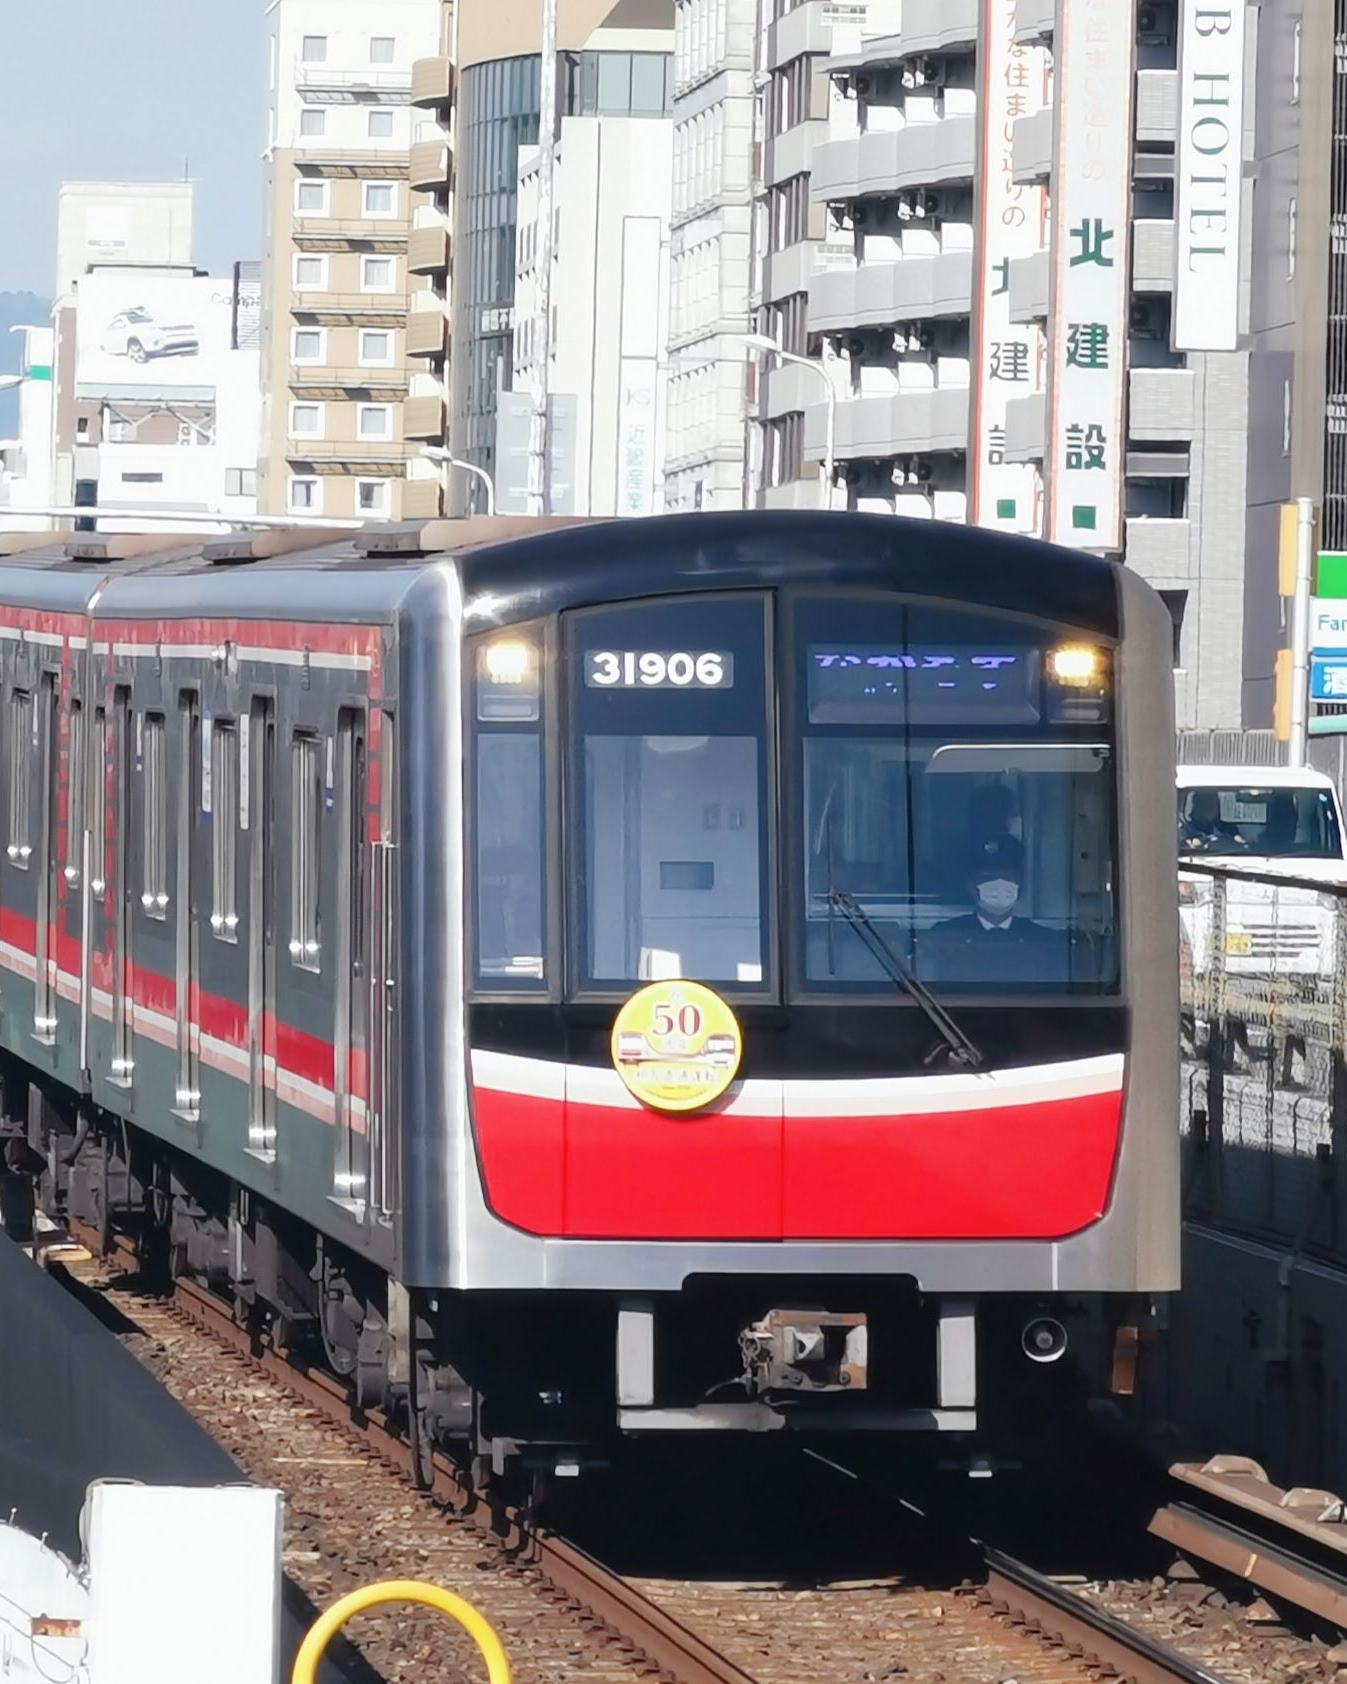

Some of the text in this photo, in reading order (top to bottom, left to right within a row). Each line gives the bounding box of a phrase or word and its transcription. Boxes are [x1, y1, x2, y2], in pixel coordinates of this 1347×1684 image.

[1189, 72, 1230, 273] HOTEL
[1066, 218, 1114, 470] 北建設
[592, 652, 723, 685] 31906
[653, 1005, 700, 1036] 50
